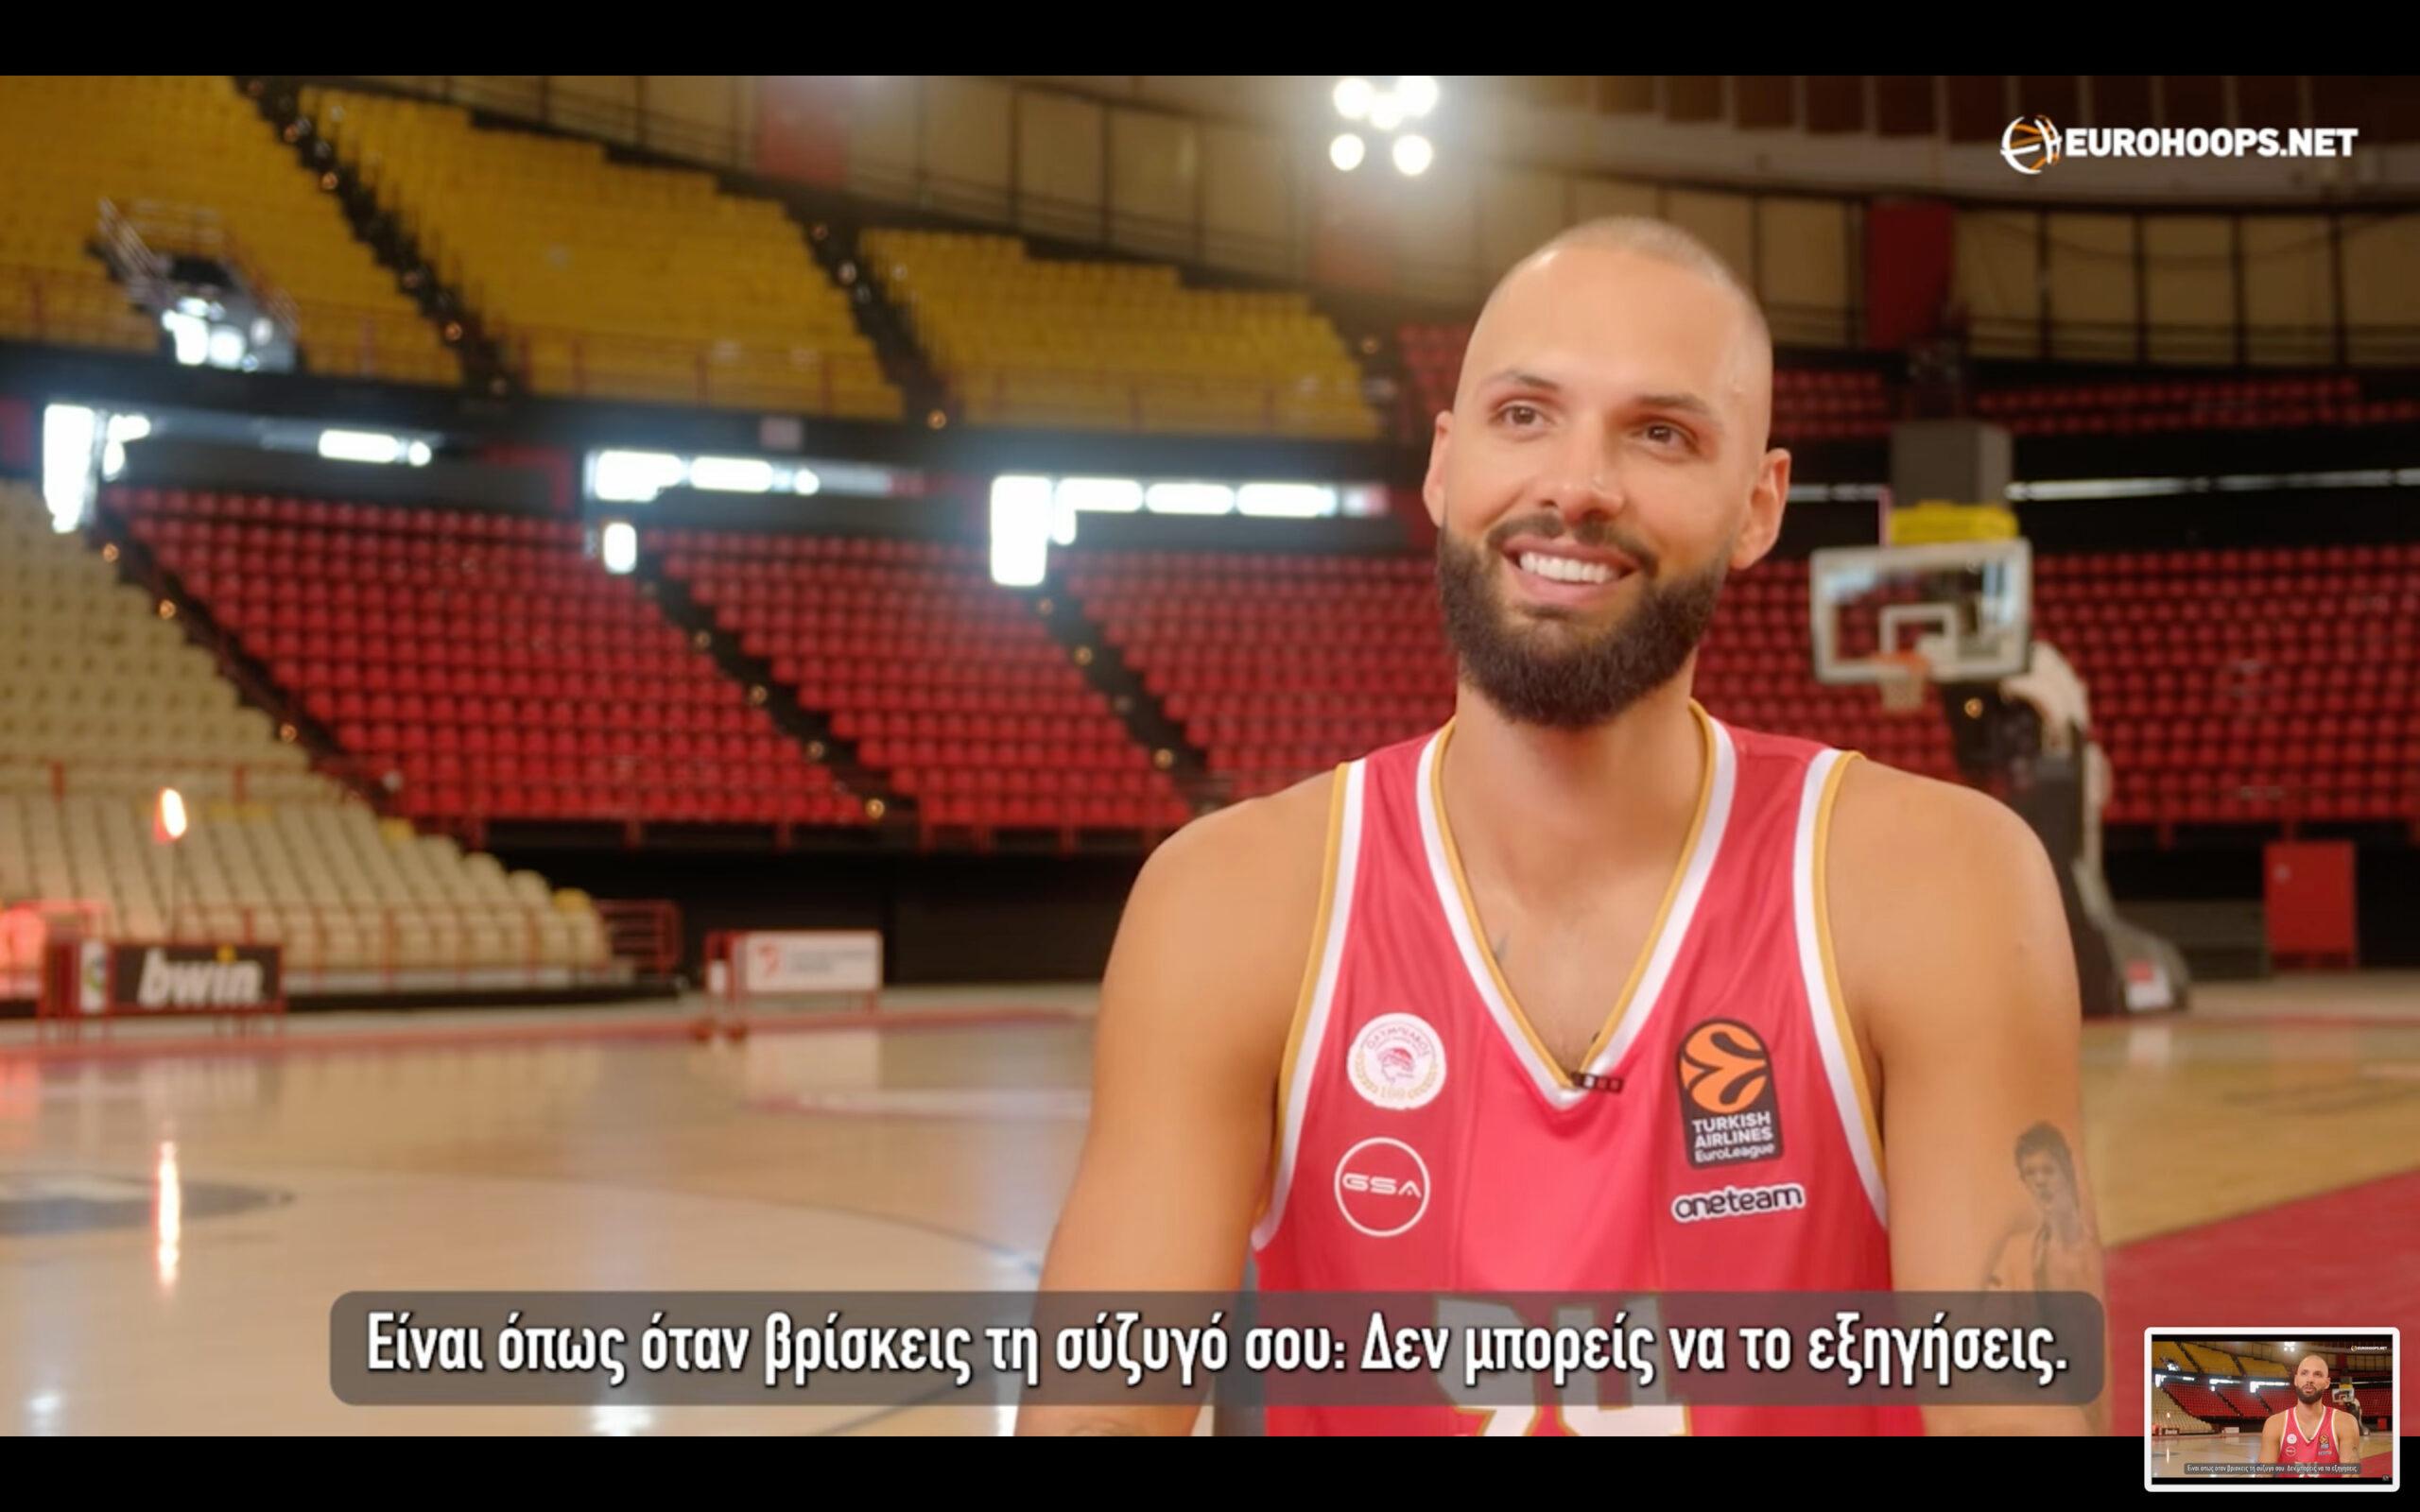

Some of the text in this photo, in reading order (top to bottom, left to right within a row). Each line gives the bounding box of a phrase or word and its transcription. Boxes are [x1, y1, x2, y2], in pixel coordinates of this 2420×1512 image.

[138, 944, 263, 1008] bwin
[1692, 1111, 1772, 1133] TURKISH
[1694, 1126, 1773, 1149] AIRLINES
[1694, 1143, 1775, 1163] EuroLeague
[1342, 1173, 1422, 1198] GSA
